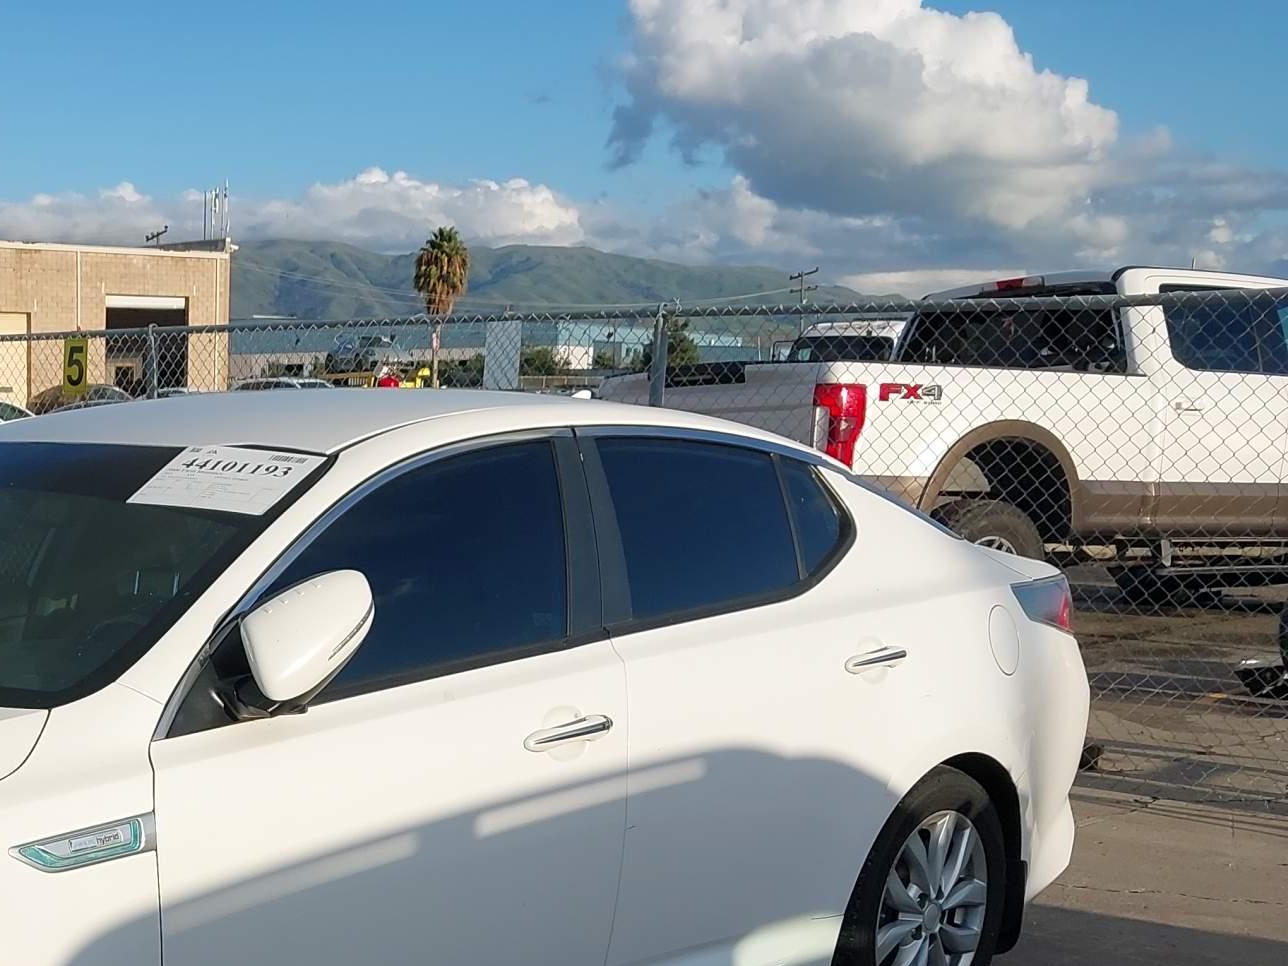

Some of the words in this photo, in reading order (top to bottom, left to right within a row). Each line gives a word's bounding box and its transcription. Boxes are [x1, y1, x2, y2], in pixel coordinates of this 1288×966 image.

[66, 345, 84, 387] 5
[878, 382, 943, 402] FX4
[181, 457, 294, 478] 44101193
